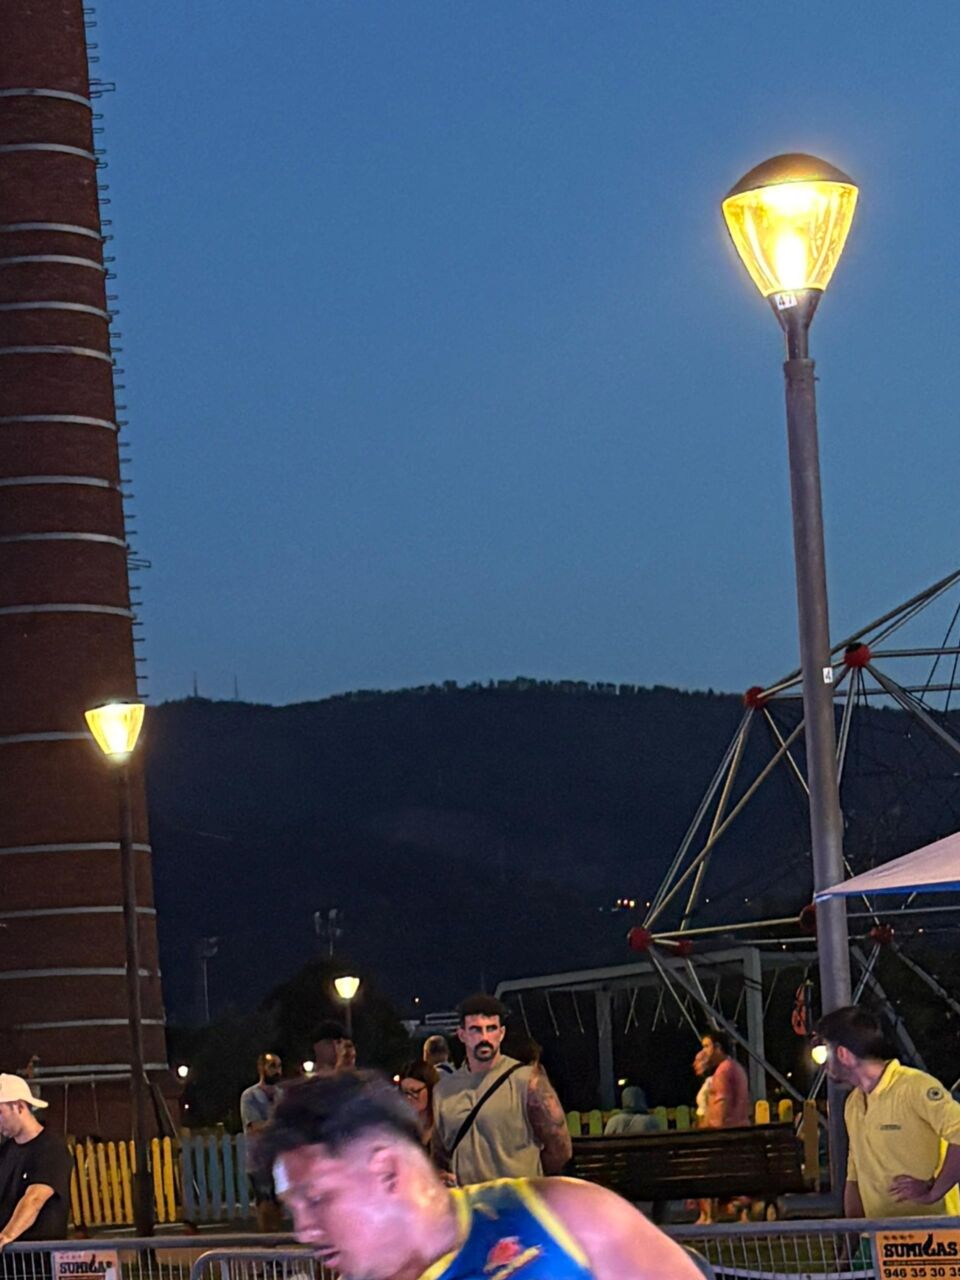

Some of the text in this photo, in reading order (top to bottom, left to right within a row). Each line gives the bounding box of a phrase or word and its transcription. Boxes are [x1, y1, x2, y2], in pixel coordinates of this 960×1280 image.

[883, 1233, 958, 1258] SUMIGAS
[883, 1268, 907, 1278] 946
[910, 1267, 927, 1277] 35
[930, 1267, 946, 1277] 30
